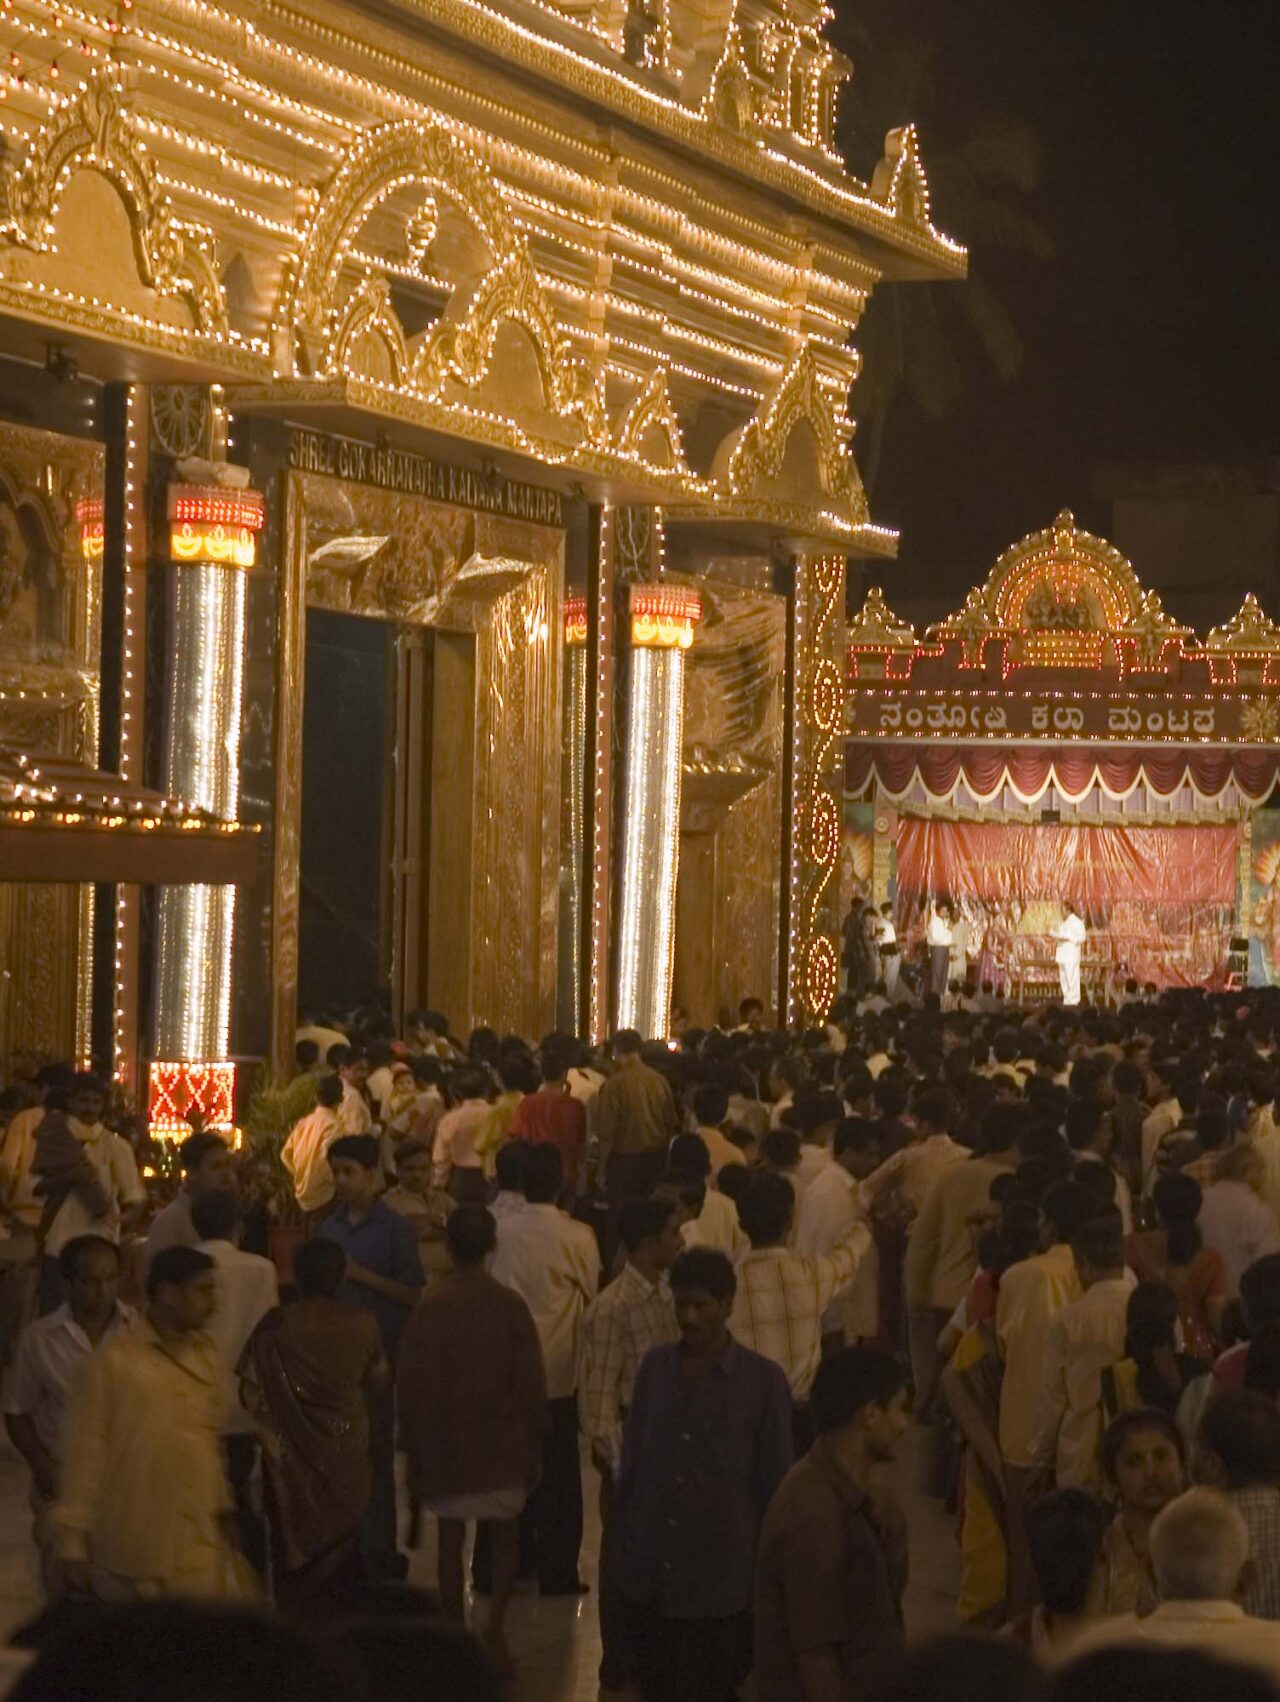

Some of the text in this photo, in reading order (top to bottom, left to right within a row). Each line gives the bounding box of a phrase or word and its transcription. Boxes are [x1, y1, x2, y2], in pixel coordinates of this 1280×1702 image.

[290, 430, 335, 474] SHREE
[1032, 704, 1084, 731] ಕಲಾ
[1108, 705, 1215, 733] ಮಂಟಪ
